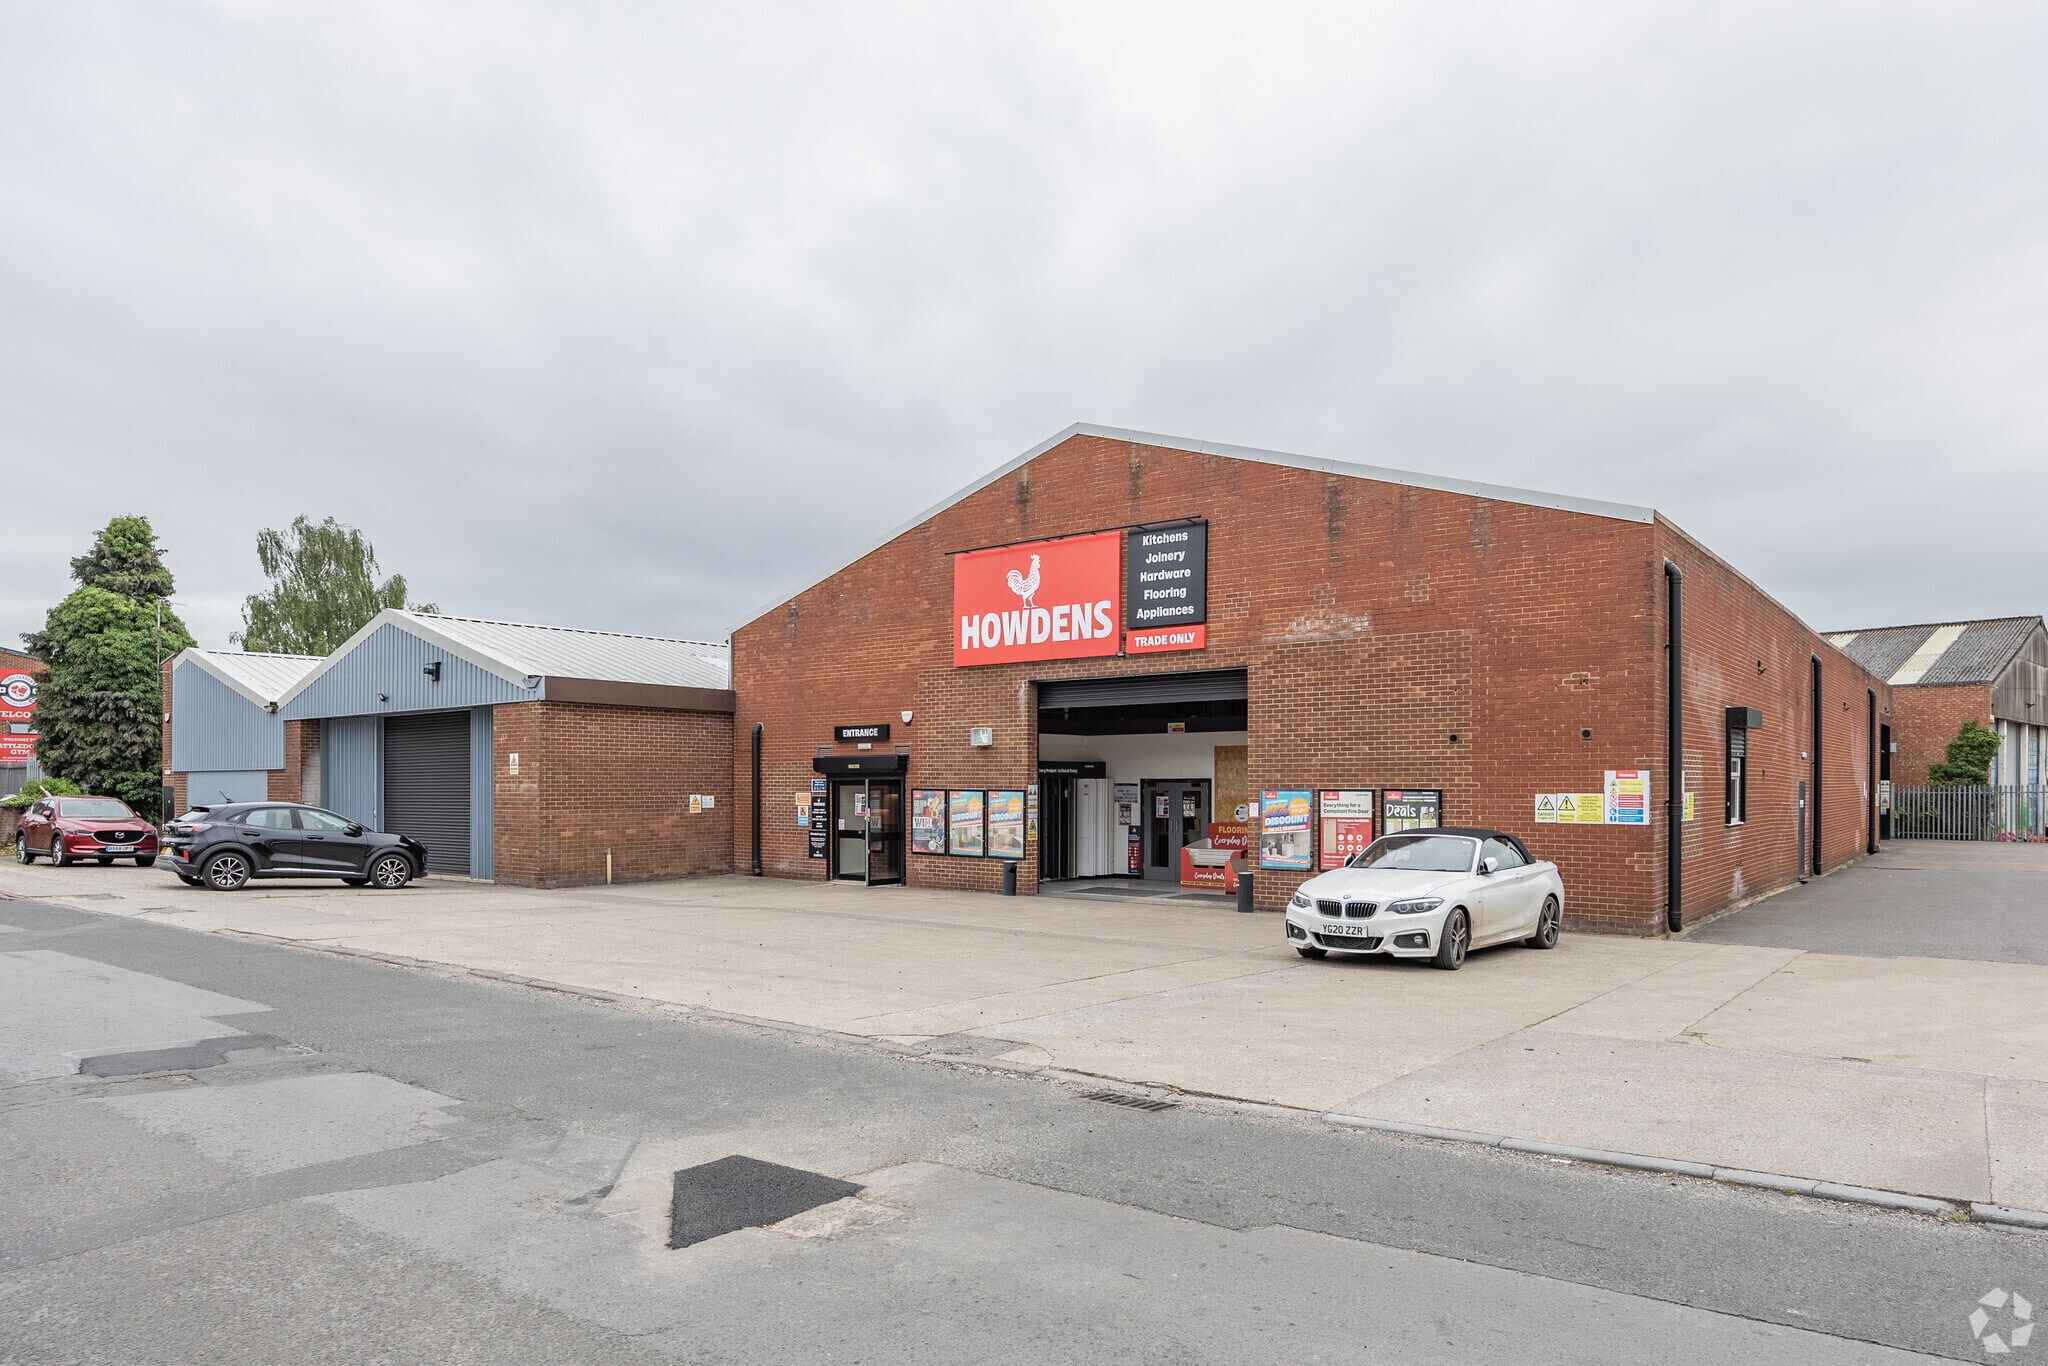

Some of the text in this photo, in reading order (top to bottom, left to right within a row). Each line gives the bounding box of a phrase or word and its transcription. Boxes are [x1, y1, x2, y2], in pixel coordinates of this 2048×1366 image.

[1142, 531, 1188, 546] Kitchens
[1145, 550, 1186, 564] Joinery
[1140, 568, 1191, 582] Hardware
[1144, 587, 1187, 600] Flooring
[1136, 604, 1194, 620] Appliances
[961, 600, 1113, 650] HOWDENS
[1134, 632, 1196, 648] TRADE ONLY
[842, 728, 878, 738] ENTRANCE
[952, 812, 982, 821] DISCOUNT
[990, 812, 1022, 821] DISCOUNT
[1386, 804, 1416, 817] Deals
[1265, 814, 1308, 826] DISCOUNT
[1214, 835, 1240, 845] Everyday
[1323, 924, 1362, 935] YG20 ZZR
